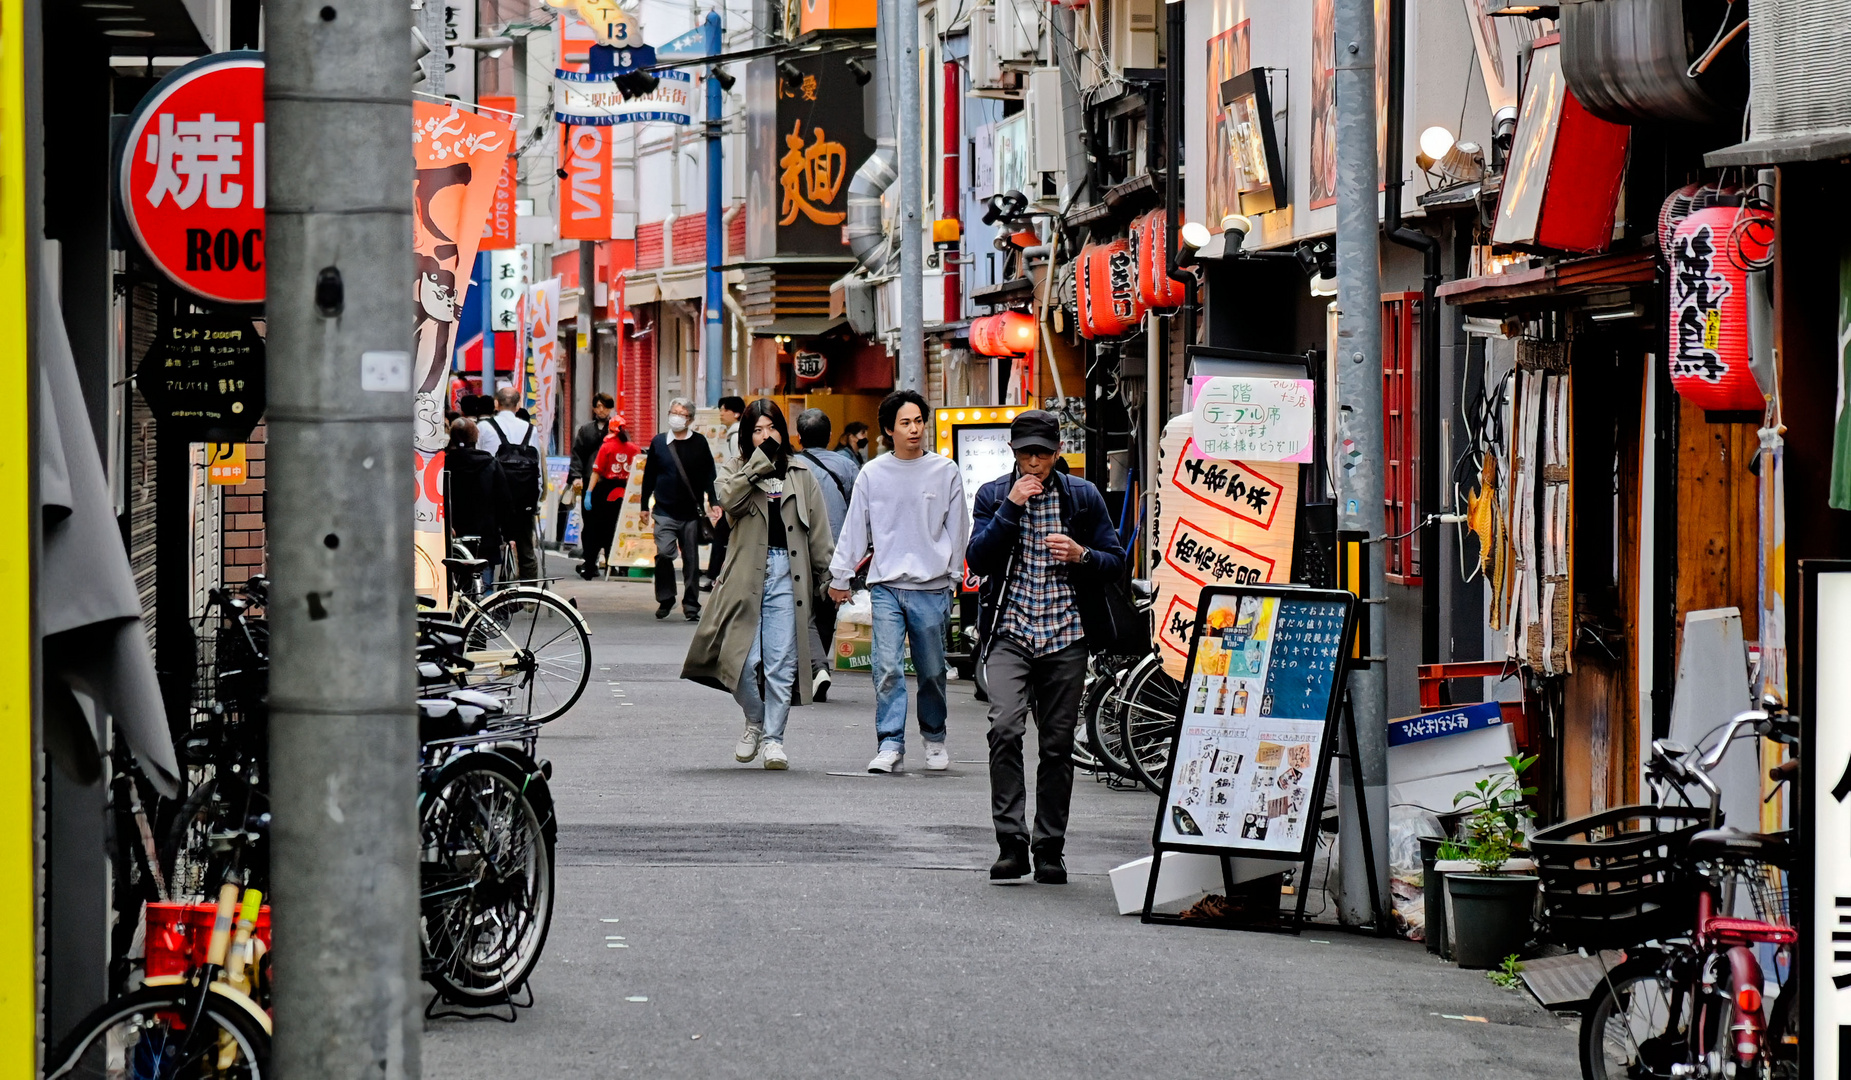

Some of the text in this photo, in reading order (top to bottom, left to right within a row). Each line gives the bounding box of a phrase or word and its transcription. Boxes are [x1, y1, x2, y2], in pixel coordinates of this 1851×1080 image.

[607, 23, 628, 40] 13
[612, 51, 632, 67] 13
[145, 113, 265, 210] 焼
[495, 202, 510, 239] SLOT
[499, 262, 516, 328] 玉の家
[1207, 383, 1252, 403] 二階
[1219, 425, 1267, 438] ございます
[1184, 458, 1271, 515] 千客万来
[1175, 532, 1262, 585] 商売繁昌
[1281, 606, 1297, 669] こだわりを
[1289, 607, 1307, 667] マルリキの
[1302, 606, 1326, 709] より親しみやすい
[1303, 606, 1317, 656] お値段で
[1317, 606, 1335, 684] より美味しく
